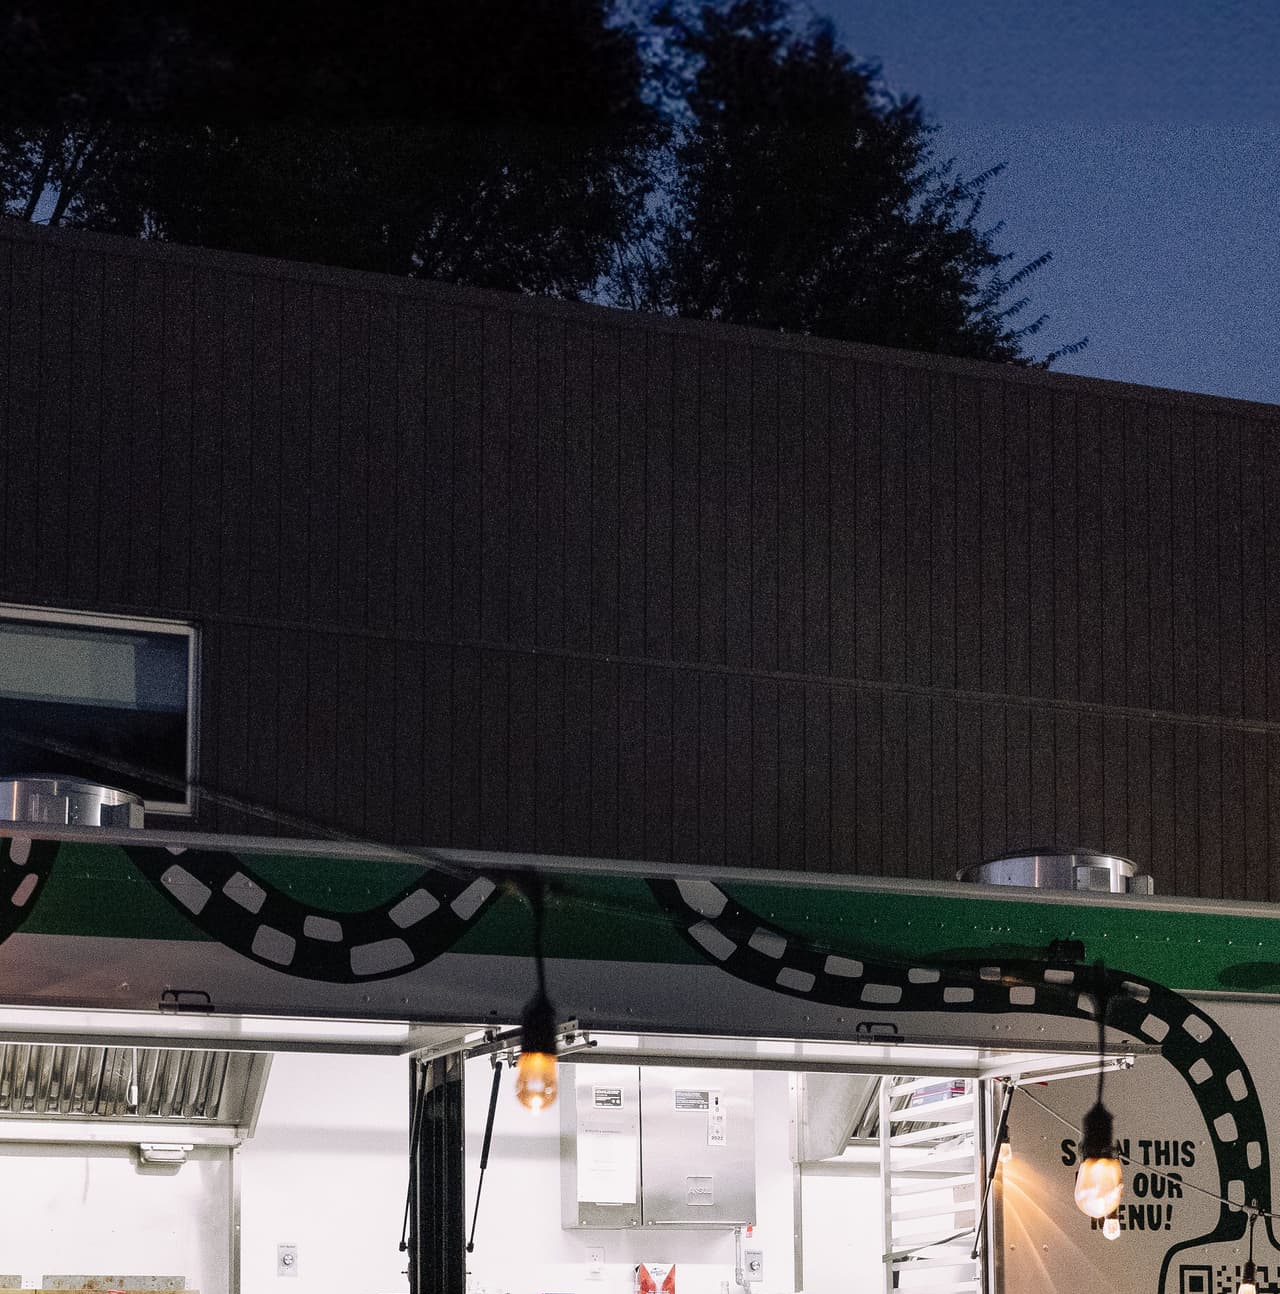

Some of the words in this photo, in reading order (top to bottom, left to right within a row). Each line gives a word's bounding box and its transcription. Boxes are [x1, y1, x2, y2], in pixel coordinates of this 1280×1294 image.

[1061, 1139, 1130, 1166] SN
[1138, 1140, 1196, 1167] THIS
[1133, 1172, 1183, 1199] OUR
